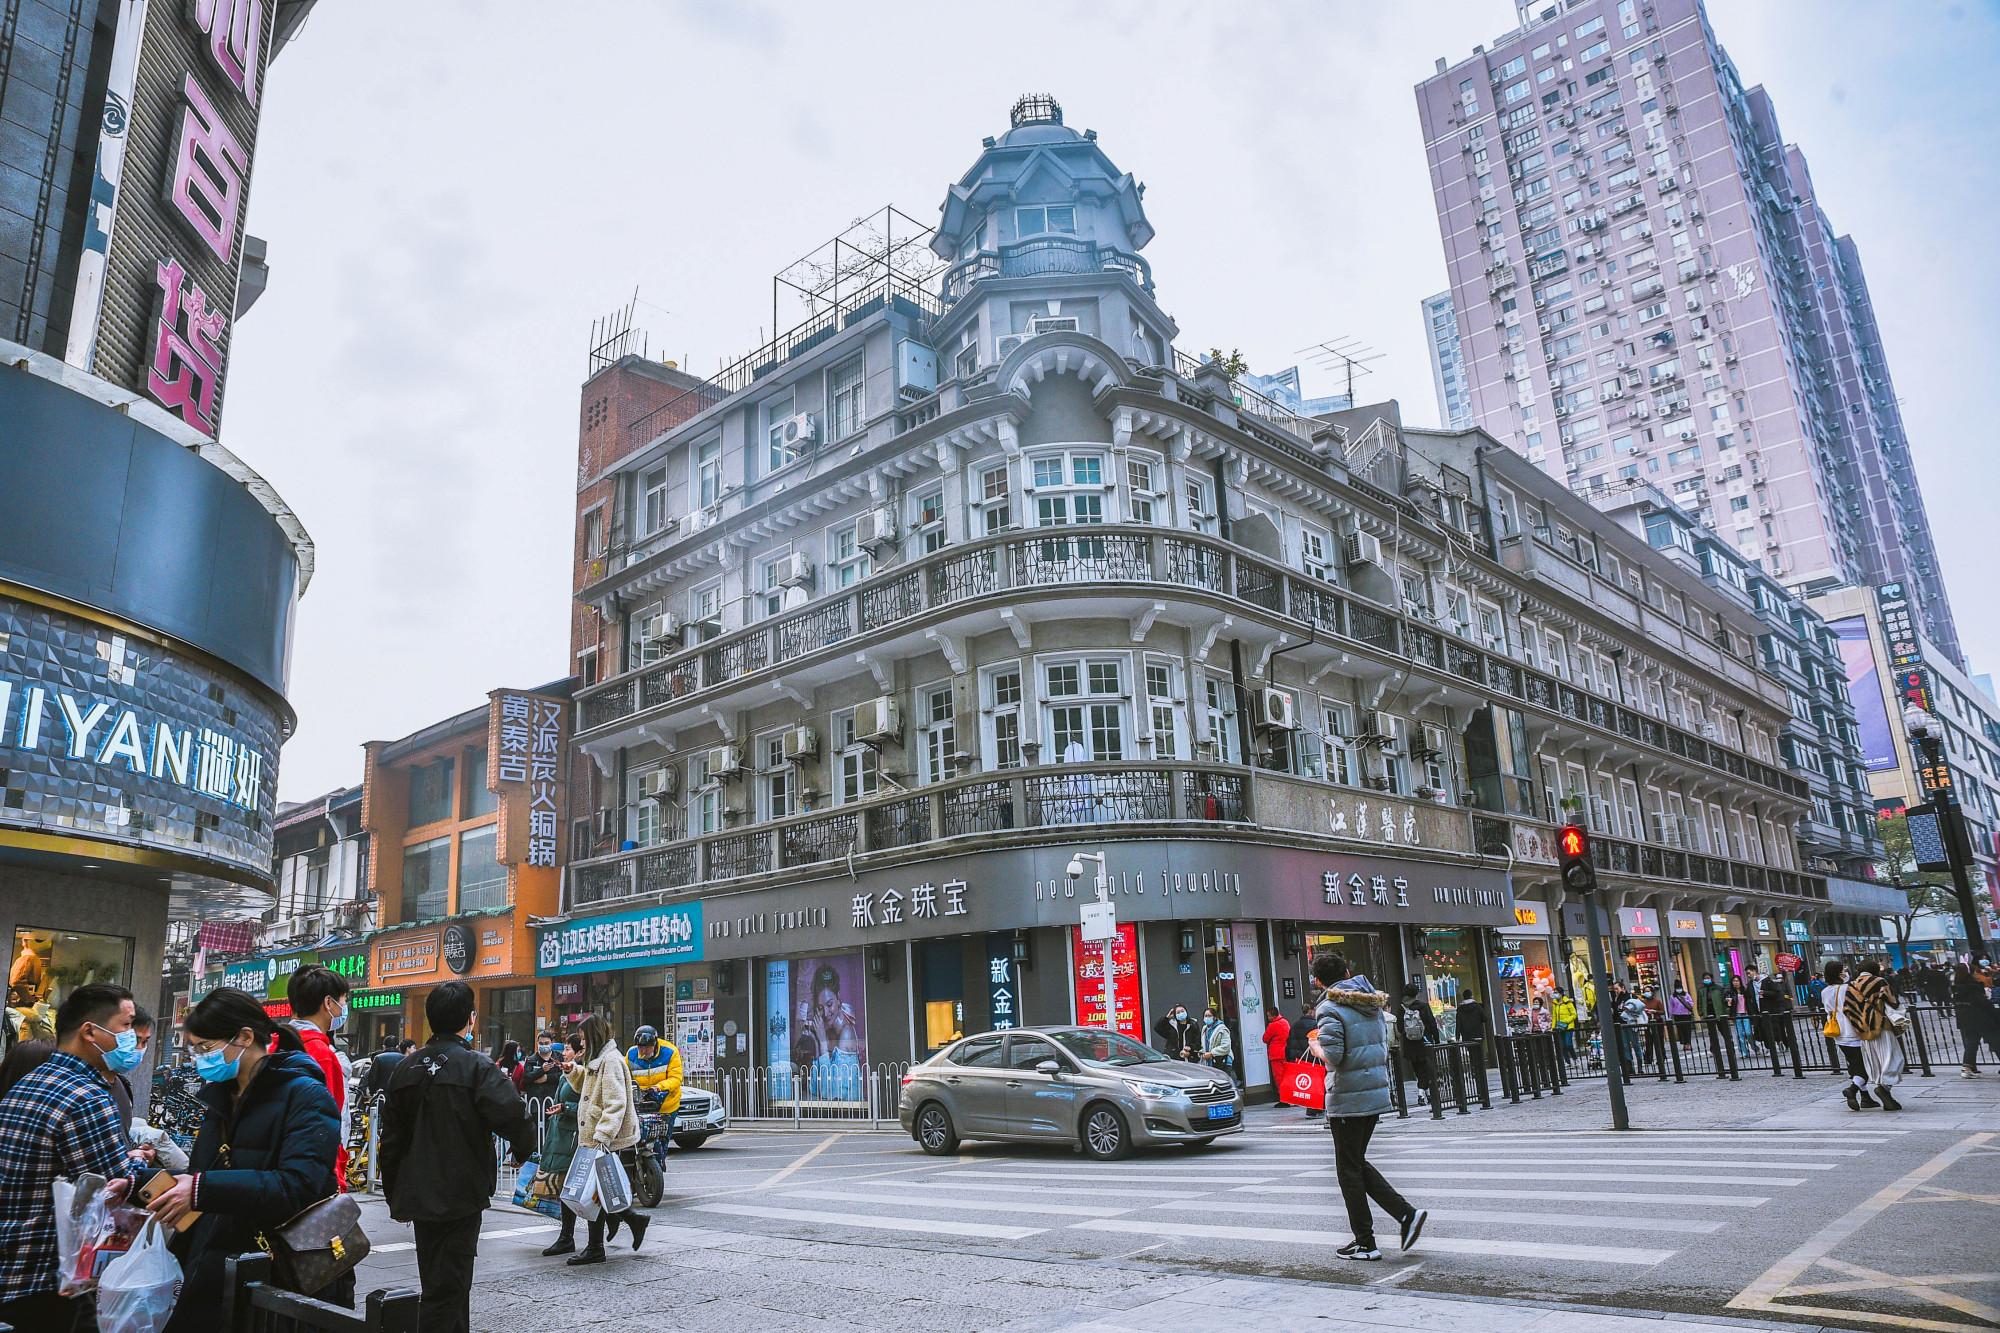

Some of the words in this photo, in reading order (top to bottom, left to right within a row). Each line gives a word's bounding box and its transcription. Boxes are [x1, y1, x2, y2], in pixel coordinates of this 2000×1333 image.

[0, 681, 192, 785] IYAN
[500, 694, 529, 782] 黄泰吉
[529, 698, 561, 868] 汉派炭火铜锅
[852, 878, 968, 928] 新金珠宝
[1036, 876, 1075, 901] new
[1162, 869, 1242, 897] jewelry
[1324, 870, 1410, 908] 新金珠宝
[561, 912, 693, 956] 江汉区水塔街社区卫生服务中心
[709, 920, 730, 939] new
[737, 912, 765, 938] gold
[773, 906, 828, 935] jewelry
[444, 941, 466, 960] 黄泰吉
